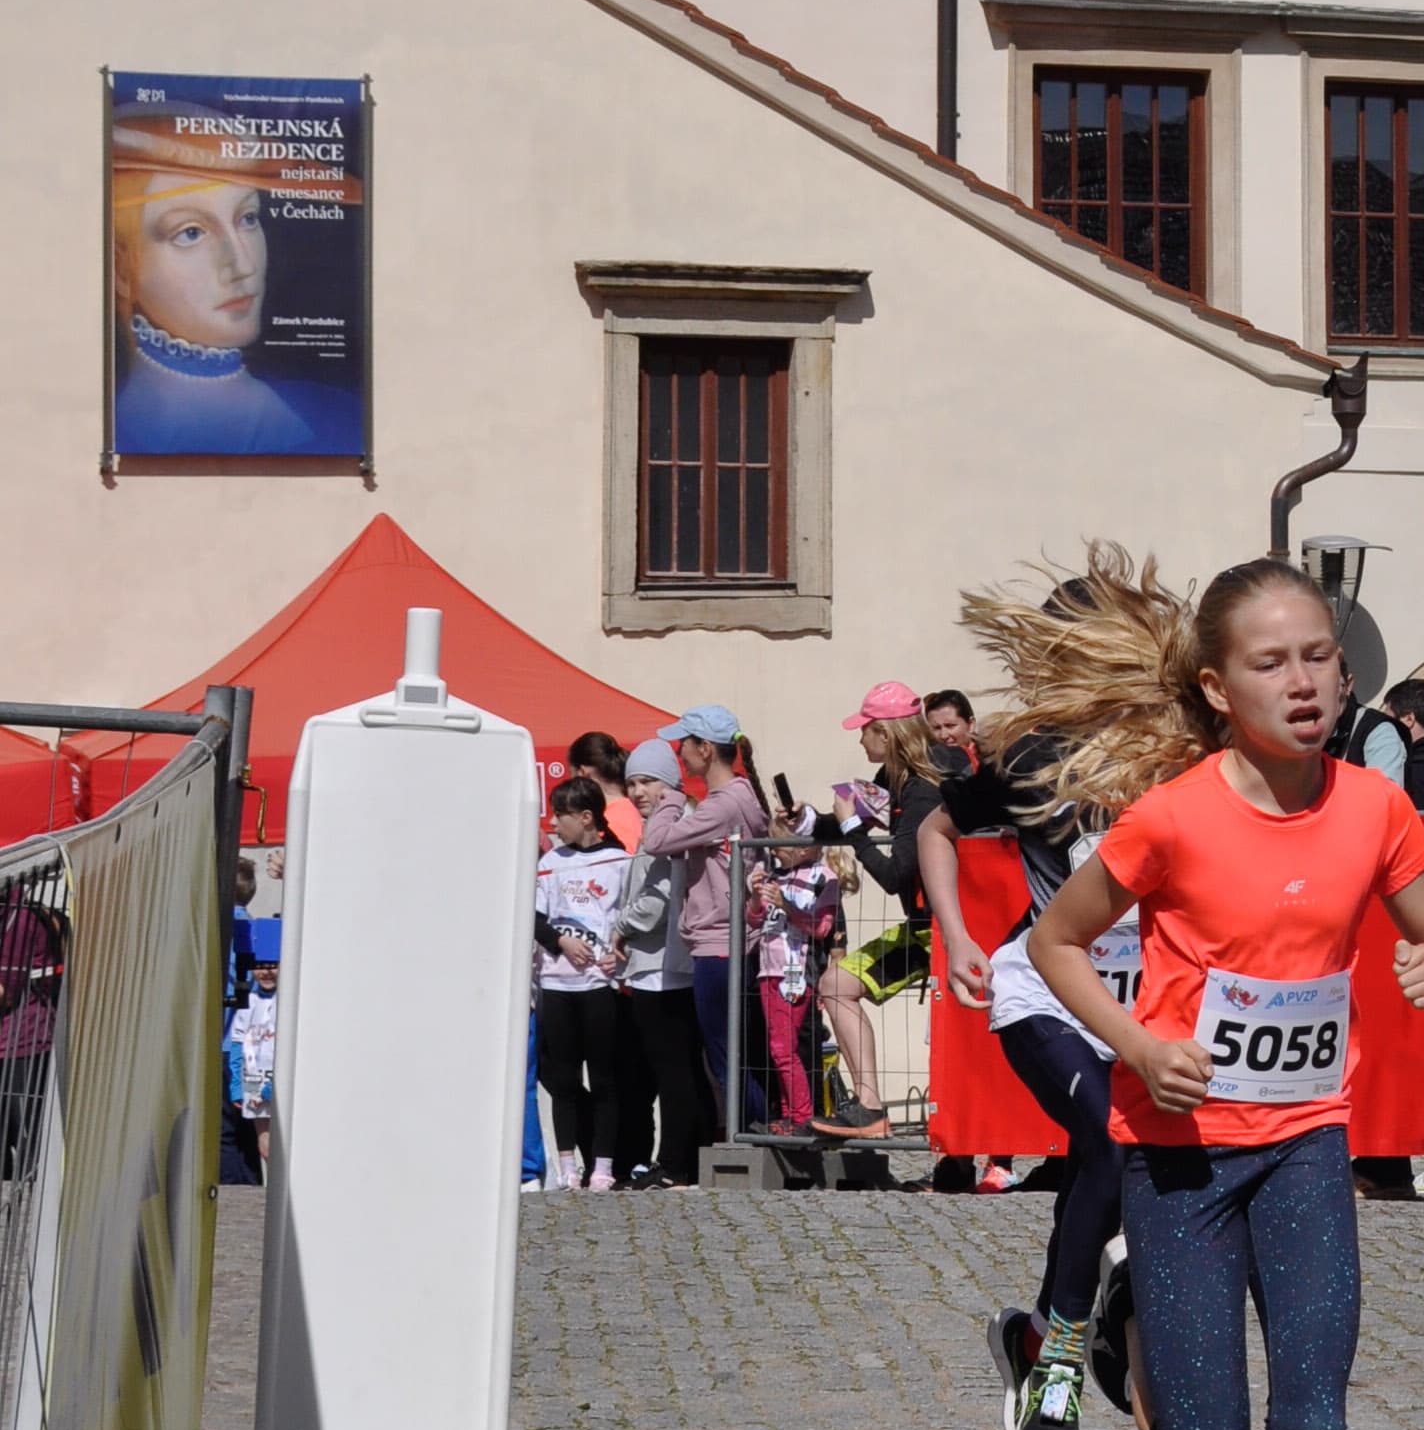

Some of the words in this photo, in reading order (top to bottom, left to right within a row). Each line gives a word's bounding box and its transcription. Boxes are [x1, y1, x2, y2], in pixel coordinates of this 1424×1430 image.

[174, 115, 345, 138] PERNŠTEJNSKÁ
[220, 142, 345, 161] REZIDENCE
[281, 167, 345, 181] nejstarší
[271, 187, 345, 200] renesance
[269, 207, 280, 216] v
[282, 203, 345, 220] Čechách
[1286, 990, 1318, 1003] PVZP
[1211, 1019, 1338, 1072] 5058
